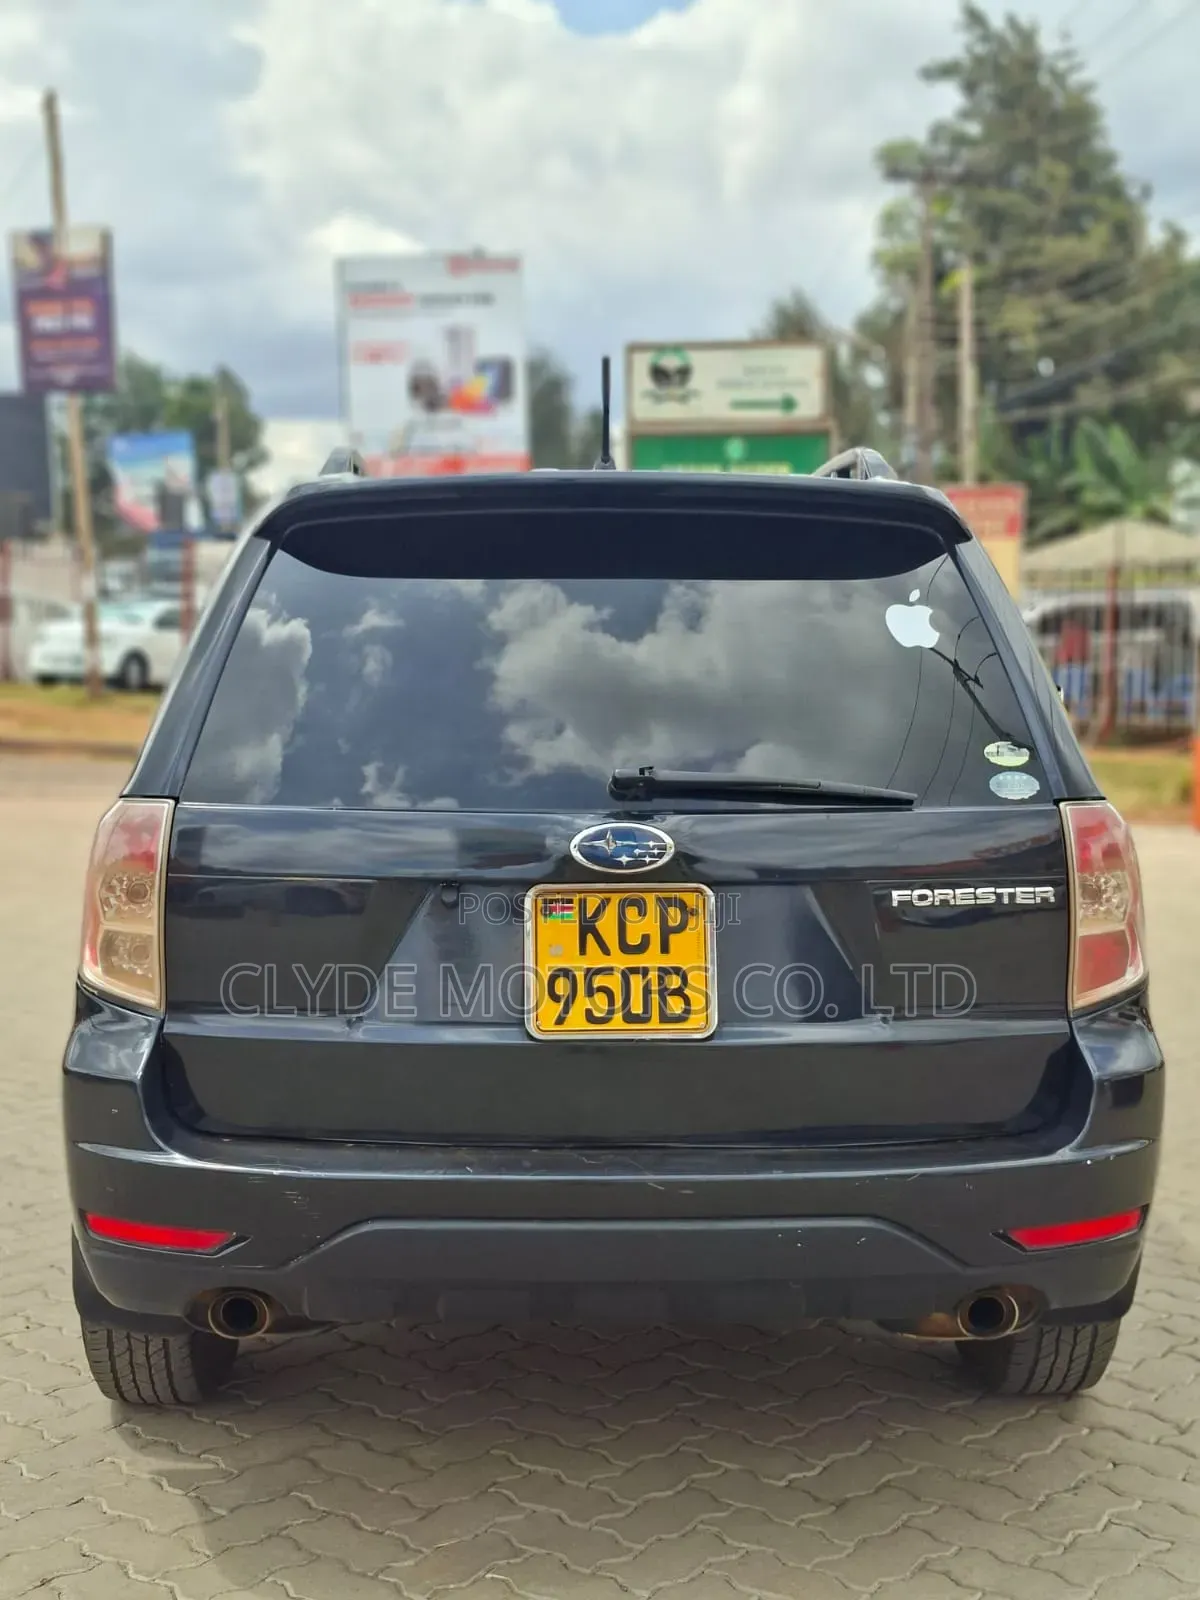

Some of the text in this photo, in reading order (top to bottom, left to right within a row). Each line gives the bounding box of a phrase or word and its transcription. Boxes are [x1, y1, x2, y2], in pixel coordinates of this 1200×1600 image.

[578, 896, 692, 956] KCP
[891, 886, 1056, 908] FORESTER
[546, 966, 692, 1025] 950B
